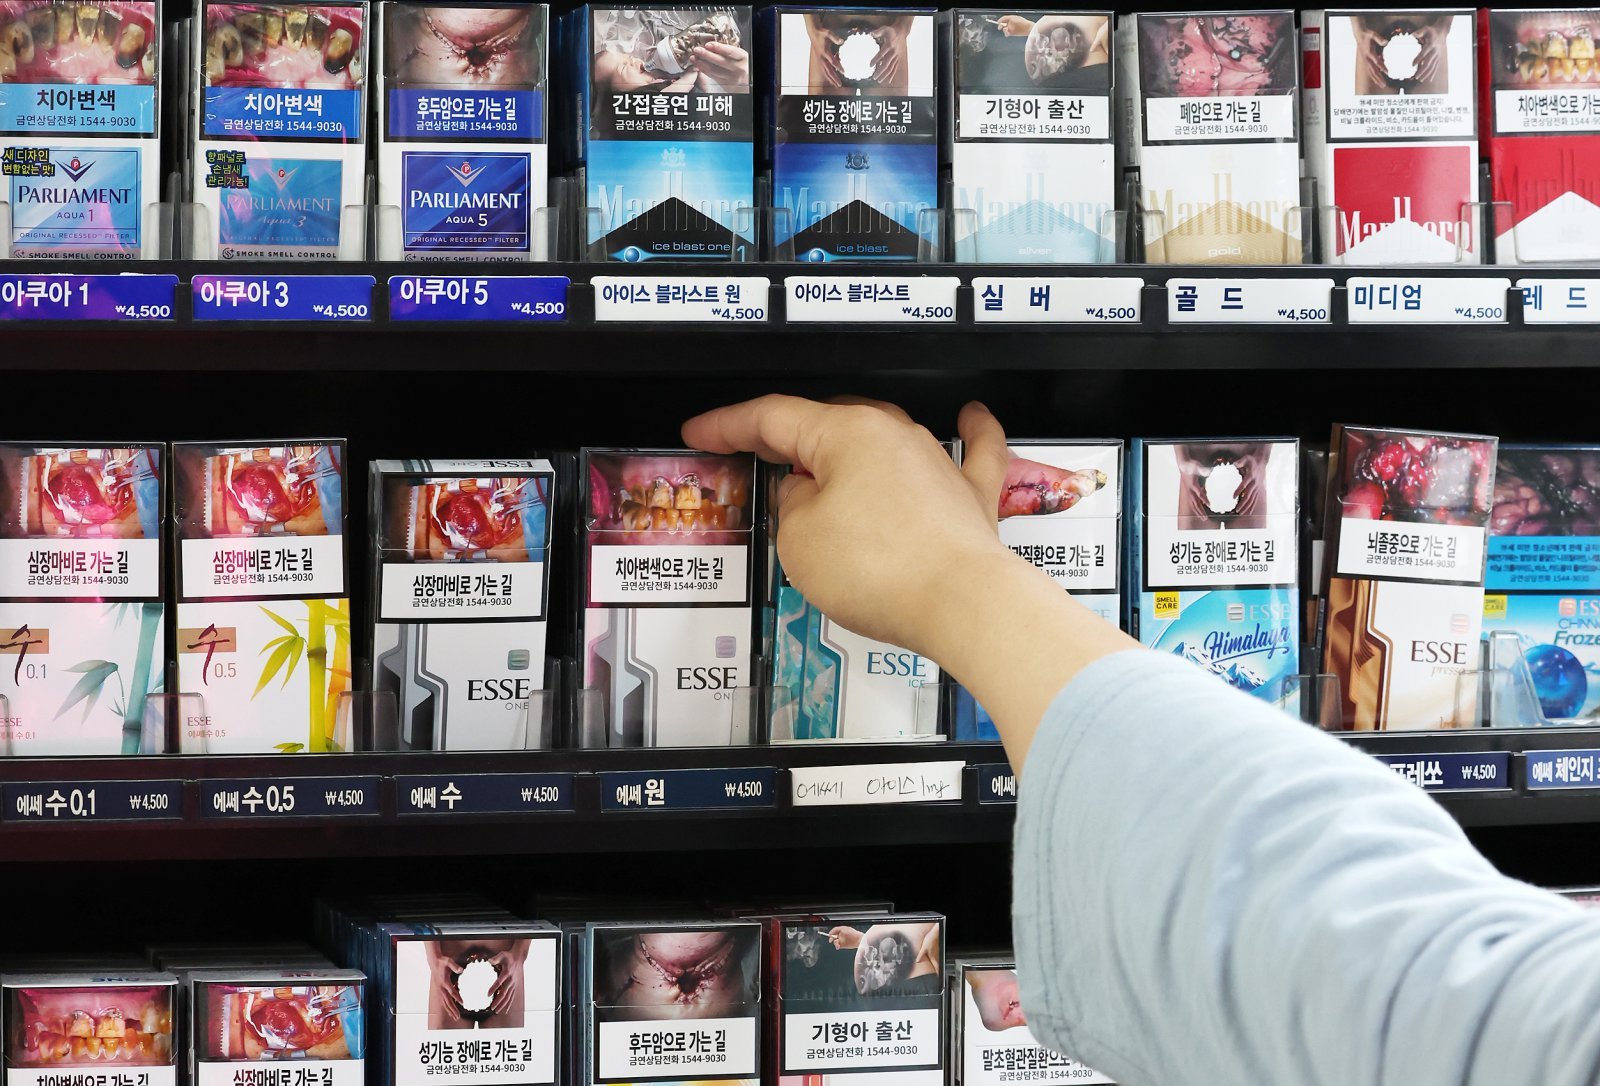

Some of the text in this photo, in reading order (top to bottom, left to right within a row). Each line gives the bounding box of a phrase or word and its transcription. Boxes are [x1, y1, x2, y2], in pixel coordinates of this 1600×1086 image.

[37, 90, 115, 111] 치아변색
[244, 94, 323, 115] 치아변색
[417, 97, 516, 121] 후두암으로 가는 길
[612, 94, 733, 117] 간접흡연 피해
[986, 98, 1085, 120] 기형아 출산
[802, 100, 912, 124] 성기능 장애로 가는 길
[1180, 101, 1261, 124] 폐암으로 가는 길
[16, 116, 136, 127] 금연상담전화 1544-9030
[223, 120, 342, 132] 금연상담전화 1544-9030
[416, 121, 517, 131] 금연상담전화 1544-9030
[615, 120, 731, 131] 금연상담전화 1544-9030
[808, 124, 906, 134] 금연상담전화 1544-9030
[979, 124, 1091, 135] 금연상담전화 1544-9030
[1174, 124, 1268, 135] 금연상담전화 1544-9030
[17, 150, 49, 162] 디자인
[3, 164, 40, 176] 변함없는
[213, 164, 241, 175] 손냄새
[207, 176, 248, 188] 관리가능!
[18, 185, 131, 204] PARLIAMENT
[410, 190, 522, 209] PARLIAMENT
[598, 170, 750, 234] Marlboro
[226, 194, 335, 213] PARLIAMENT
[783, 173, 933, 234] Marlboro
[959, 172, 1115, 236] Marlboro
[1148, 173, 1298, 237] Marlboro
[57, 211, 85, 220] AQUA
[446, 213, 488, 227] AQUA 5
[652, 242, 670, 251] ice
[672, 241, 706, 251] blast
[707, 243, 731, 251] one
[836, 244, 888, 253] ice blast
[1208, 247, 1241, 258] gold
[1, 280, 89, 308] 아쿠아 1
[201, 280, 289, 308] 아쿠아 3
[400, 278, 489, 306] 아쿠아 5
[602, 284, 741, 304] 아이스 블라스트 원
[795, 283, 910, 303] 아이스 블라스트
[1354, 284, 1421, 311] 미디엄
[115, 304, 171, 319] ₩4,500
[313, 304, 368, 319] ₩4,500
[511, 302, 565, 315] ₩4,500
[711, 308, 764, 321] ₩4,500
[902, 306, 953, 320] ₩4,500
[1085, 307, 1136, 321] ₩4,500
[1277, 308, 1327, 322] ₩4,500
[1454, 307, 1503, 320] ₩4,500
[1169, 540, 1275, 564] 성기능 장애로 가는 길
[1367, 531, 1457, 558] 뇌졸중으로 가는 길
[27, 550, 129, 575] 심장마비로 가는 길
[213, 547, 313, 574] 심장마비로 가는 길
[615, 557, 724, 581] 치아변색으로 가는 길
[1366, 554, 1456, 568] 금연상담전화 1544-9030
[1176, 564, 1268, 575] 금연상담전화 1544-9030
[27, 575, 129, 585] 금연상담전화 1544-9030
[213, 573, 313, 584] 금연상담전화 1544-9030
[413, 574, 512, 597] 심장마비로 가는 길
[621, 581, 718, 591] 금연상담전화 1544-9030
[412, 597, 512, 608] 금연상담전화 1544-9030
[1250, 603, 1291, 621] ESSE
[1203, 623, 1290, 660] Himalaya
[1411, 640, 1467, 665] ESSE
[26, 663, 46, 679] 0.1
[214, 662, 237, 679] 0.5
[867, 651, 926, 677] ESSE
[676, 667, 738, 690] ESSE
[908, 679, 926, 689] ICE
[467, 678, 531, 701] ESSE
[505, 702, 529, 711] ONE
[187, 716, 212, 727] ESSE
[1555, 756, 1594, 782] 체인지
[410, 782, 559, 809] 에쎄 수 ₩4,500
[616, 778, 762, 806] 에쎄 원 ₩4,500
[812, 1020, 913, 1043] 기형아 출산
[629, 1030, 726, 1055] 후두암으로 가는 길
[418, 1039, 532, 1064] 성기능 장애로 가는 길
[629, 1054, 726, 1065] 금연상담전화 1544-9030
[806, 1045, 918, 1059] 금연상담전화 1544-9030
[426, 1063, 526, 1075] 금연상담전화 1544-9030
[1000, 1069, 1093, 1081] 금연상담전화 1544-9030
